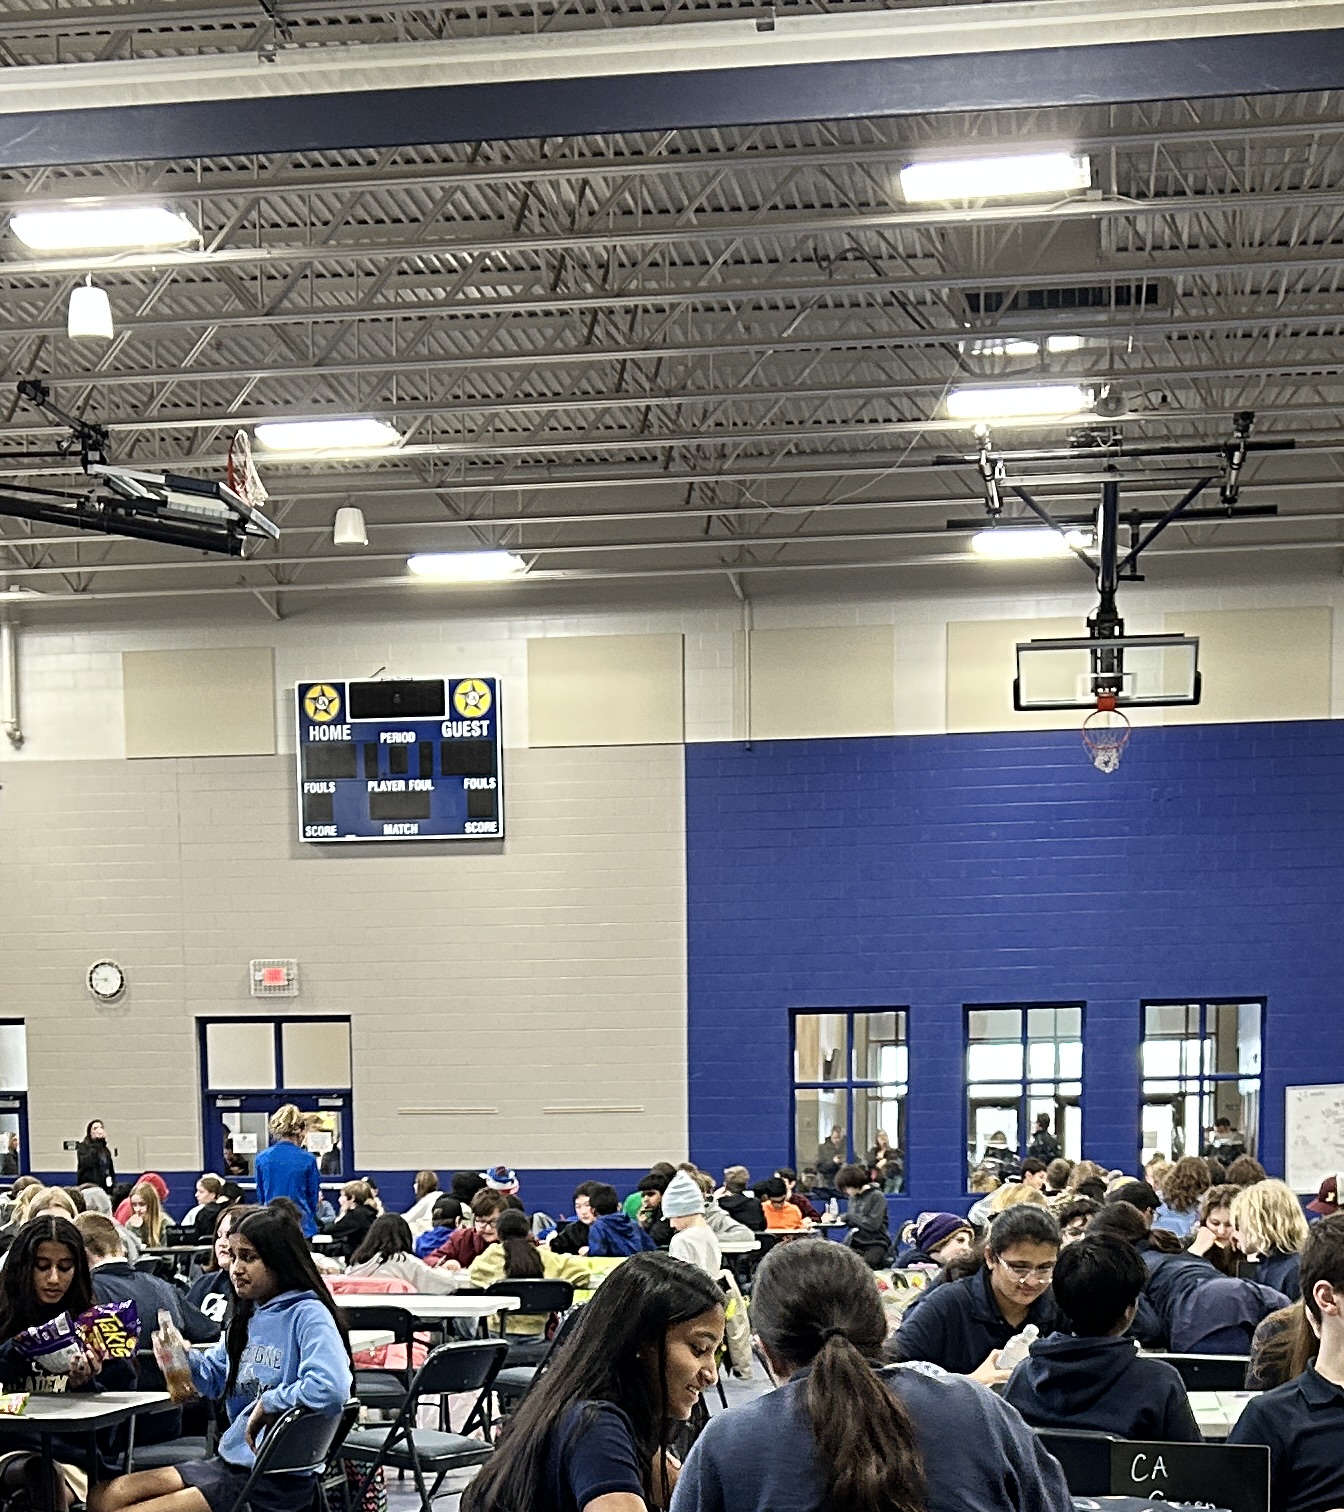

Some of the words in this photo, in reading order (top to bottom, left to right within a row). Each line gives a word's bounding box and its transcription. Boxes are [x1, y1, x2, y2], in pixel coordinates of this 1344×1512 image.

[309, 724, 351, 741] HOME
[441, 720, 490, 738] GUEST
[380, 731, 416, 743] PERIOD
[304, 781, 336, 793] FOULS
[368, 780, 405, 792] PLAYER
[408, 779, 435, 791] FOUL
[463, 777, 496, 789] FOULS
[305, 824, 338, 837] SCORE
[383, 823, 419, 835] MATCH
[464, 821, 498, 833] SCORE
[1131, 1453, 1169, 1482] CA
